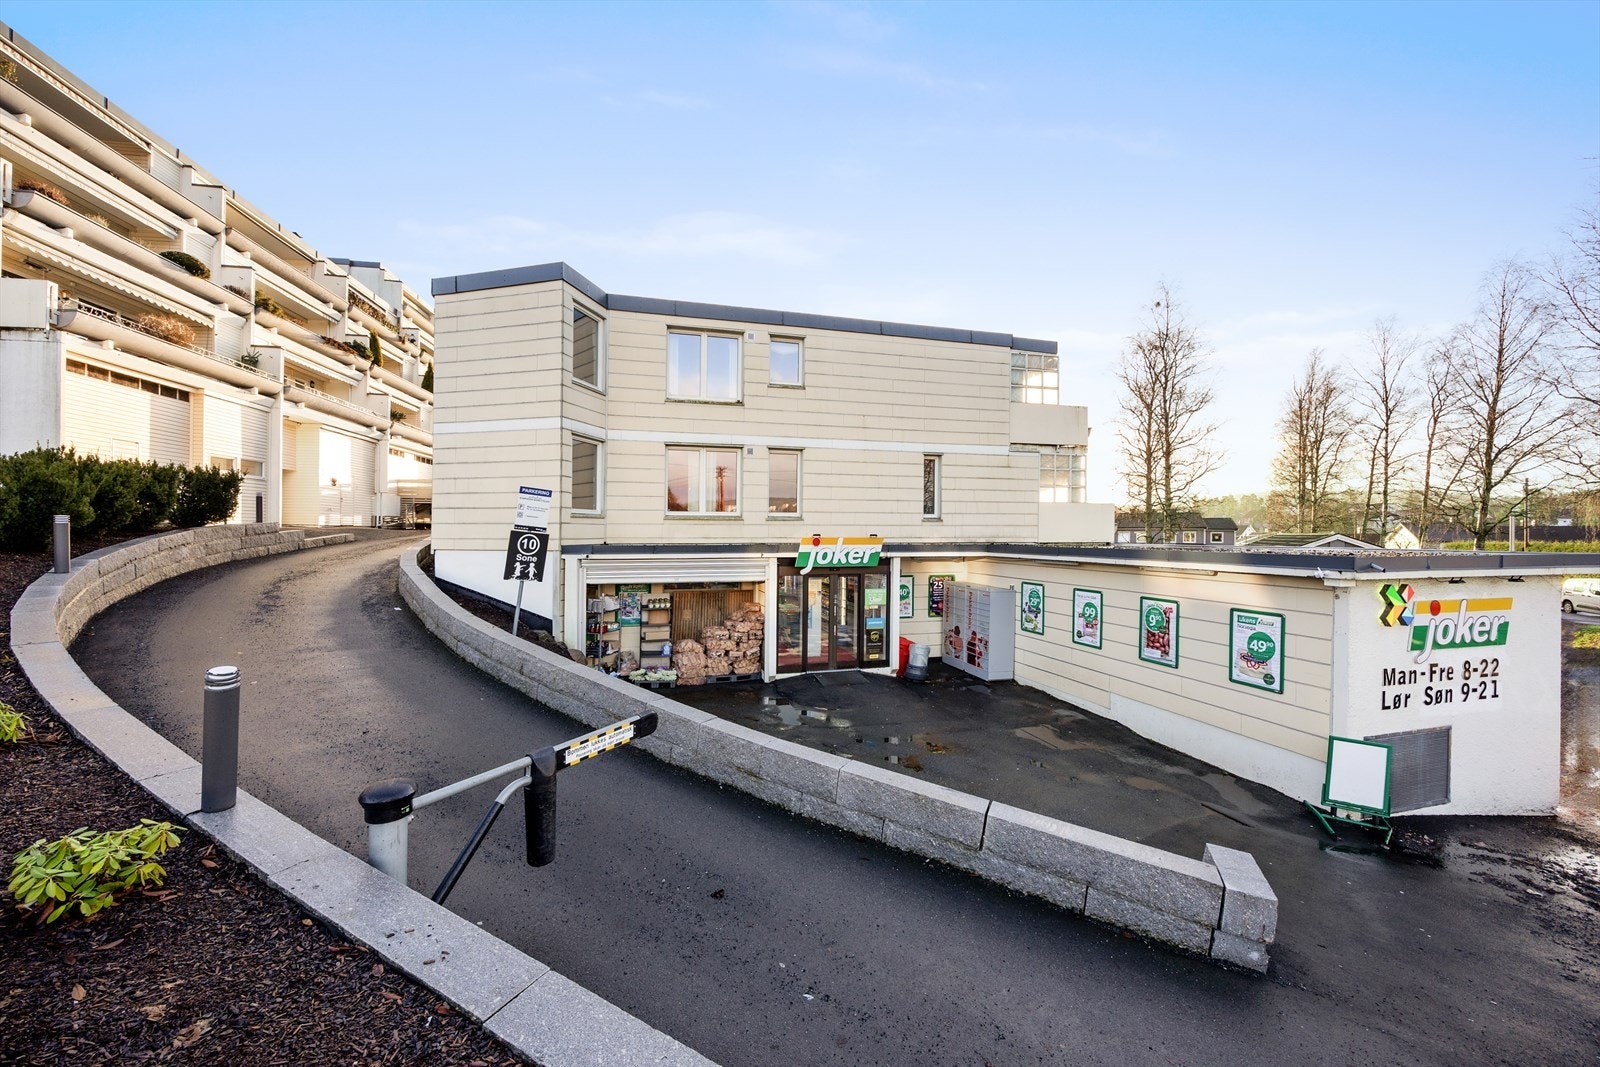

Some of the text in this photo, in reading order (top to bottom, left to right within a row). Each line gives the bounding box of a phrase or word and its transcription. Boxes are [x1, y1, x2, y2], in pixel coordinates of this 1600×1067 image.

[521, 488, 550, 496] PARKERING
[522, 538, 537, 550] 10
[516, 554, 538, 563] Sone
[800, 537, 878, 575] joker
[933, 581, 944, 589] 25
[1084, 606, 1096, 618] 99
[1414, 599, 1507, 664] joker
[1383, 658, 1500, 686] Man-Fre 8-22
[1381, 680, 1499, 710] Lør Søn 9-21
[567, 744, 589, 756] Bommen
